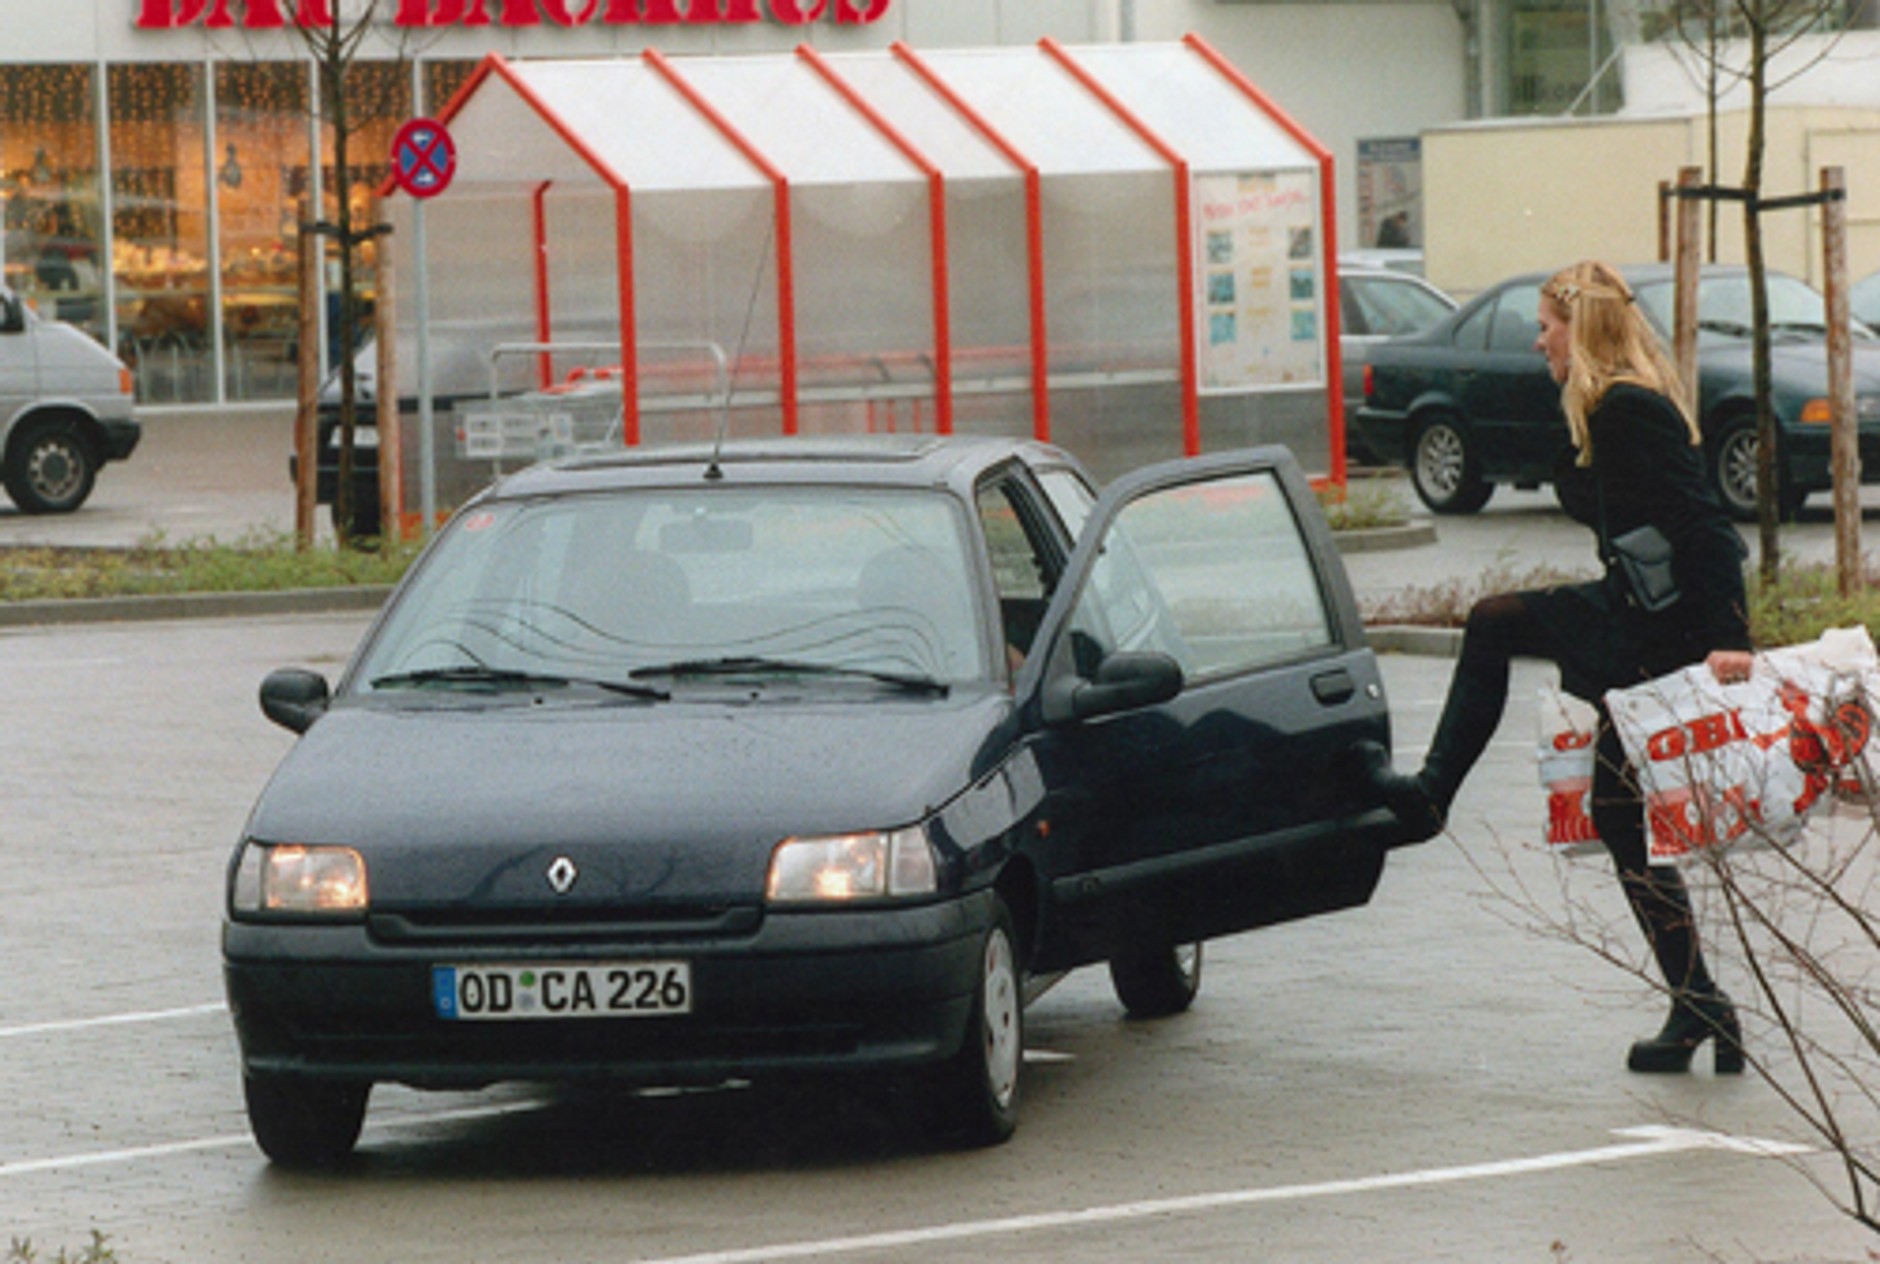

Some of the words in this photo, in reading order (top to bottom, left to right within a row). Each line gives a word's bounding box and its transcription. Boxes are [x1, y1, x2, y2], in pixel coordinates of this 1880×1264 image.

[460, 973, 513, 1012] OD
[541, 970, 596, 1011] CA
[607, 968, 686, 1009] 226
